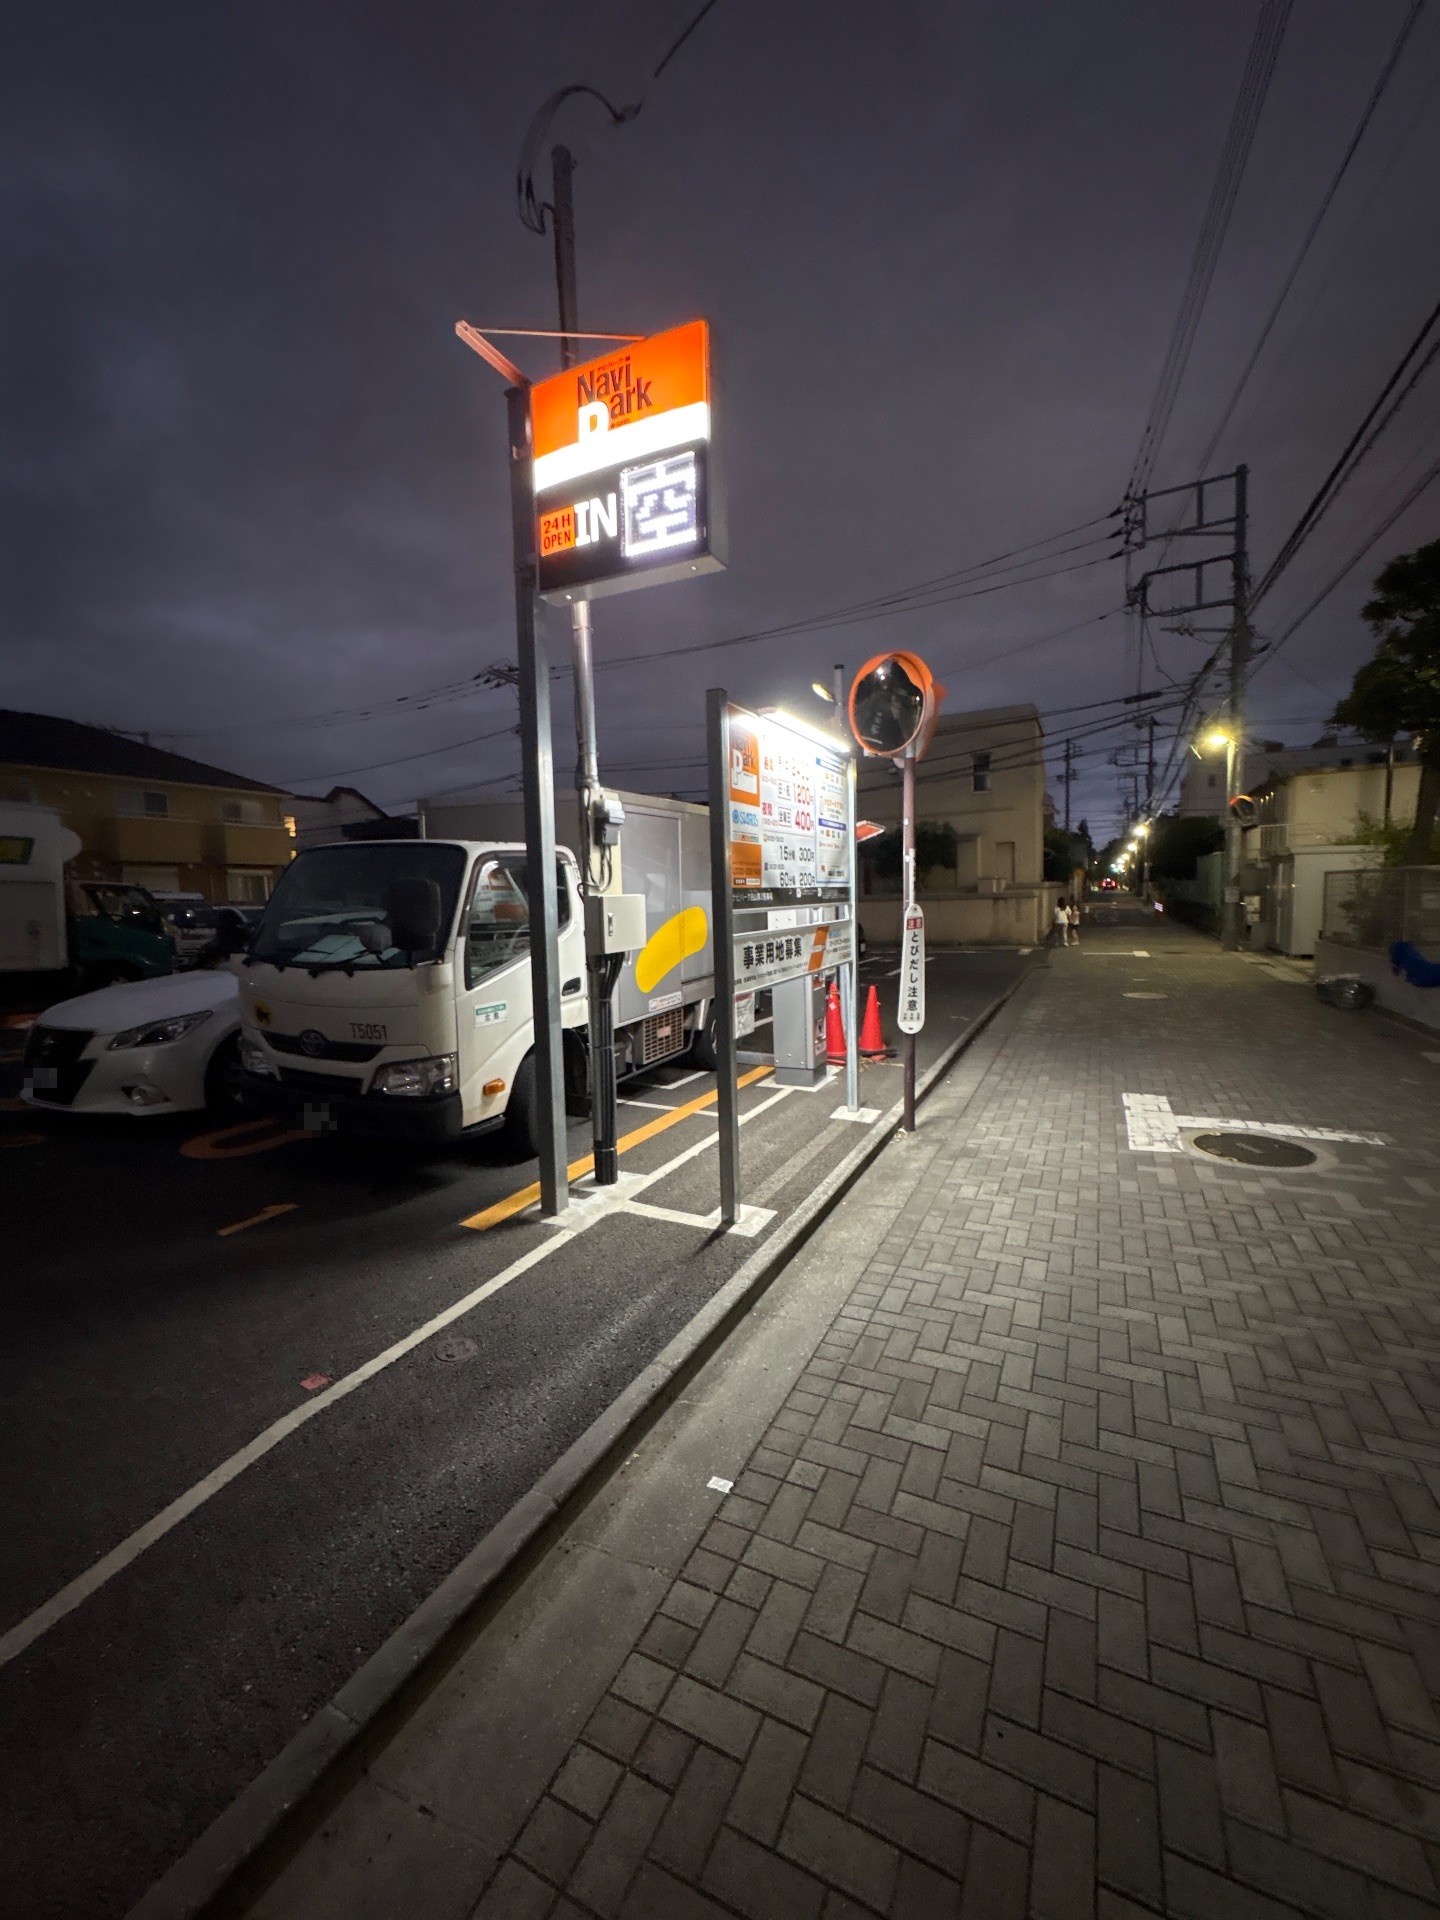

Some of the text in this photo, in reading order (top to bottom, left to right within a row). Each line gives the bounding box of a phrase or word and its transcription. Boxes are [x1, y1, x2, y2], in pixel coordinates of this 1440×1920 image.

[577, 355, 631, 407] Navi
[577, 377, 653, 443] Park
[574, 492, 618, 547] IN
[627, 457, 697, 557] 空
[543, 529, 571, 550] OPEN
[795, 810, 814, 831] 400円
[743, 937, 802, 970] 事業用地募集
[907, 931, 920, 1012] とびだし注意
[349, 1022, 388, 1041] T5051
